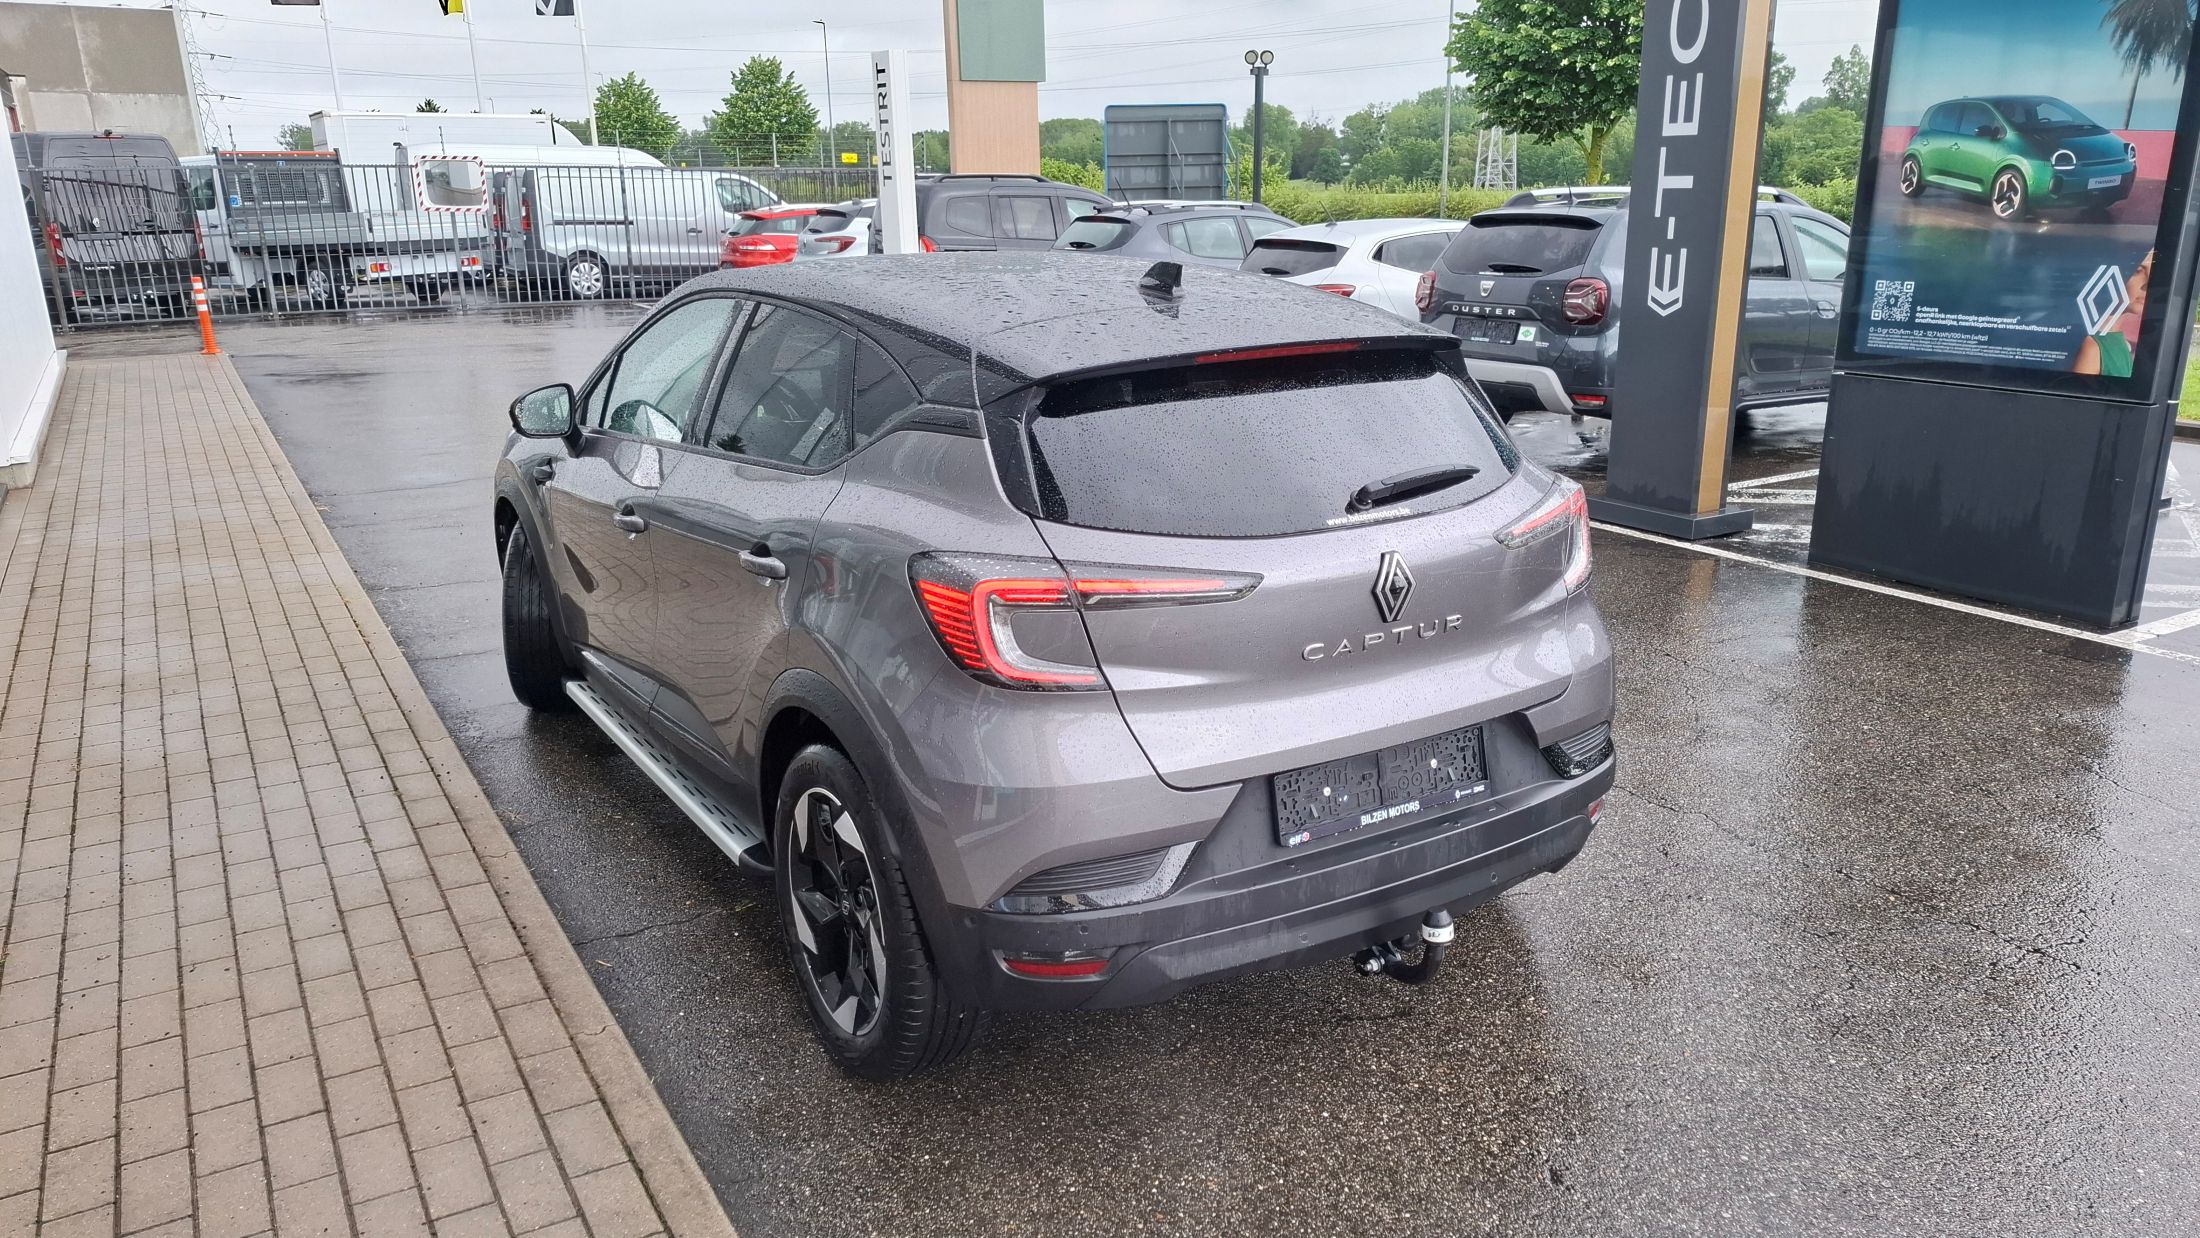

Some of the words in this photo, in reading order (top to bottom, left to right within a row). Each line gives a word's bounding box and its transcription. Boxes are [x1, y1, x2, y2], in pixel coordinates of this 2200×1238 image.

[876, 62, 893, 187] TESTRIT
[1452, 304, 1516, 316] DUSTER
[1326, 507, 1411, 525] www.bilzenmotors.be
[1302, 614, 1463, 661] CAPTUR
[1361, 809, 1387, 825] BILZEN
[1388, 800, 1420, 816] MOTORS
